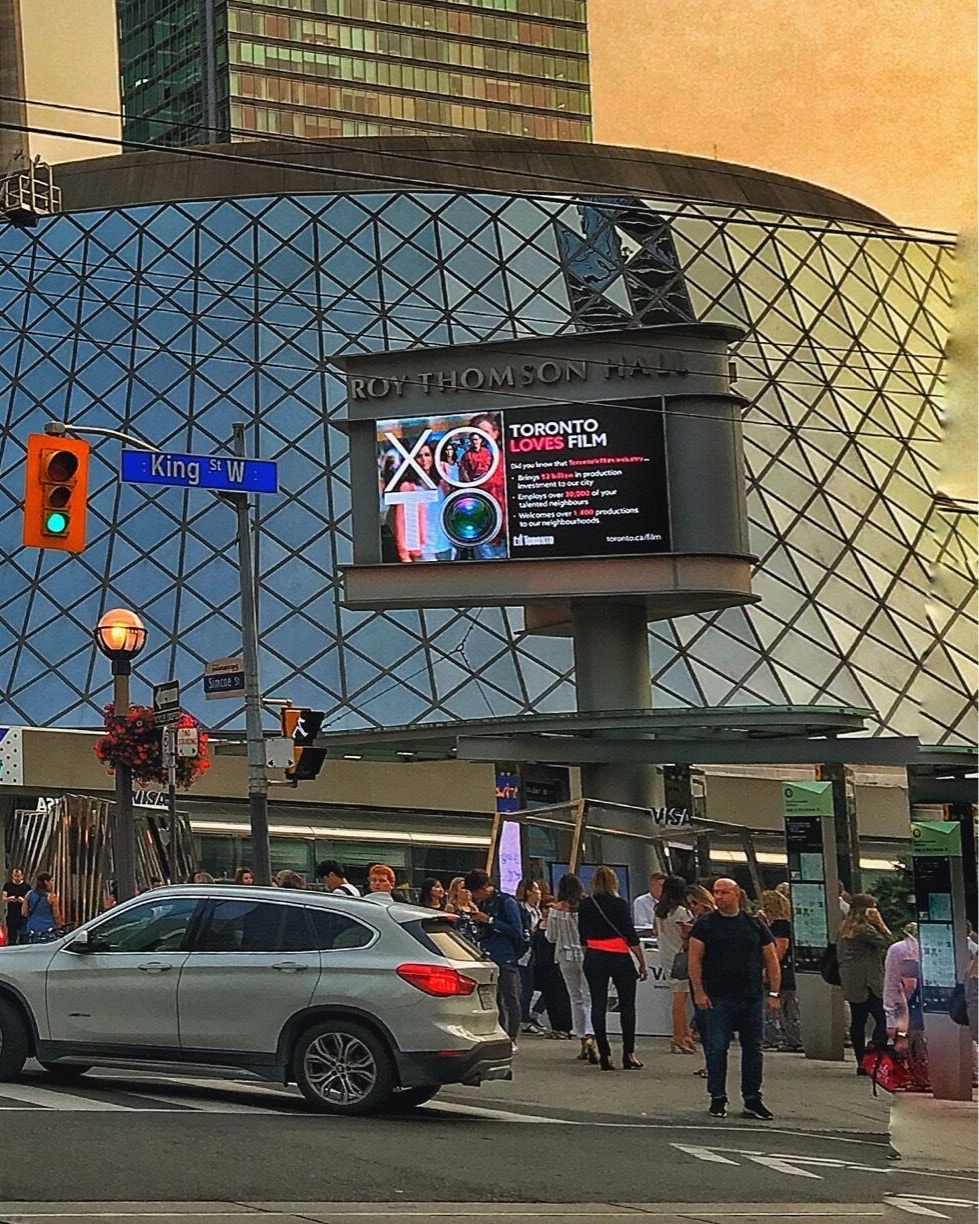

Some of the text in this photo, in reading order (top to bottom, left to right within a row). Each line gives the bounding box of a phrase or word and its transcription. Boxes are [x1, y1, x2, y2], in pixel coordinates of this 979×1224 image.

[350, 352, 688, 399] ROY THOMSON HALL
[509, 418, 599, 438] TORONTO
[510, 433, 608, 453] LOVES FILM
[384, 426, 500, 492] XO
[150, 454, 245, 486] King St W
[510, 462, 522, 470] Did
[522, 463, 535, 471] you
[517, 474, 540, 482] Brings
[582, 469, 623, 479] production
[517, 481, 557, 489] investment
[557, 480, 566, 488] to
[580, 478, 595, 487] city
[517, 492, 547, 502] Employs
[591, 488, 600, 497] of
[600, 489, 618, 498] your
[518, 498, 590, 508] talented neighbours
[517, 511, 556, 519] Welcomes
[595, 507, 640, 517] productions
[519, 520, 528, 528] to
[541, 516, 601, 528] neighbourhoods
[605, 532, 662, 543] toronto.ca/film
[208, 677, 232, 689] Simcoe
[650, 807, 692, 826] VISA
